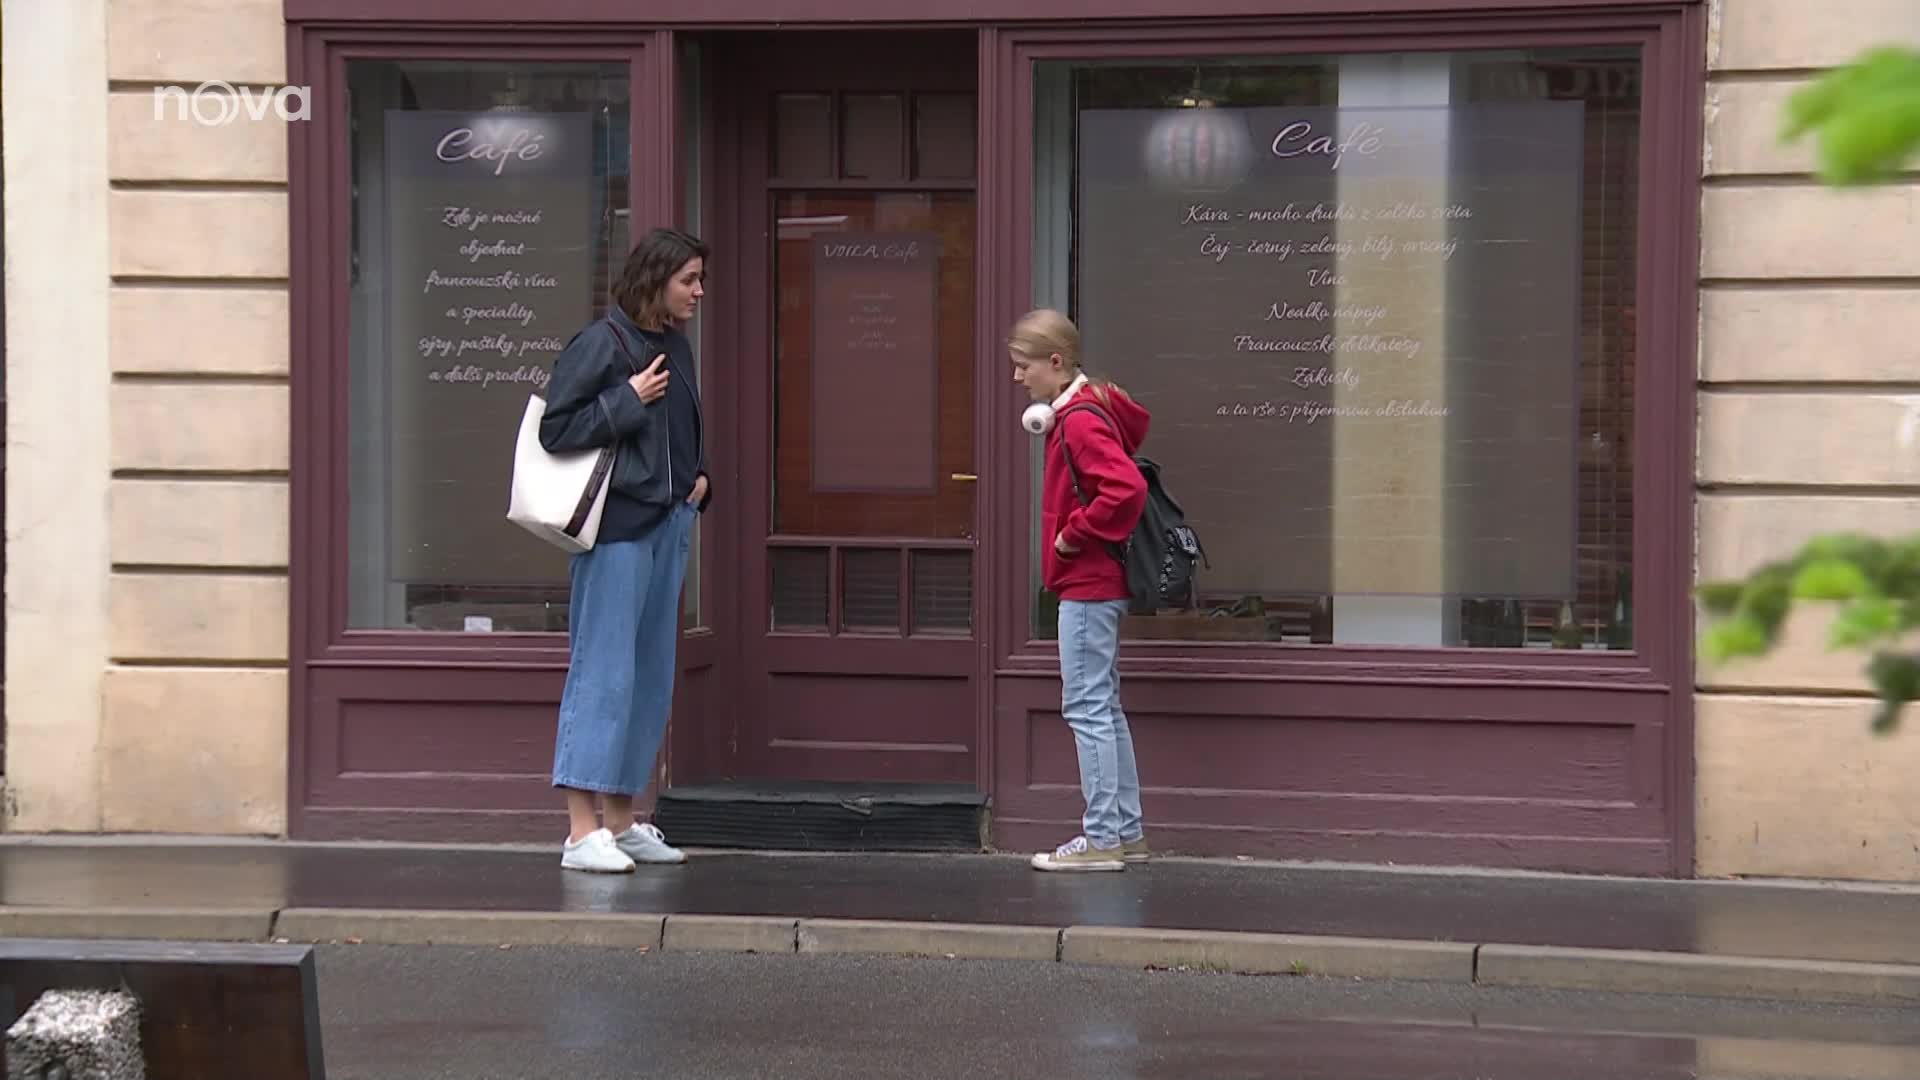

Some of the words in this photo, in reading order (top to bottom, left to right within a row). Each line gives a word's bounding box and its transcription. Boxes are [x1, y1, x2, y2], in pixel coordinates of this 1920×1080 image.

[436, 128, 544, 176] Café
[1272, 121, 1385, 170] Café
[441, 207, 471, 227] Zde
[468, 210, 490, 231] je
[492, 209, 543, 224] možné
[1182, 205, 1230, 224] Káva
[1249, 204, 1301, 221] mnoho
[459, 239, 525, 263] objednat
[1201, 234, 1230, 262] Čaj
[1247, 236, 1296, 261] černý,
[424, 269, 520, 294] francouzská
[524, 272, 557, 287] vína
[445, 308, 457, 318] a
[1264, 302, 1330, 321] Nealko
[1233, 335, 1335, 353] Francouzské
[429, 371, 441, 381] a
[445, 365, 482, 382] další
[1291, 367, 1360, 390] Zákusky
[1217, 406, 1229, 416] a
[1234, 402, 1248, 416] to
[1252, 402, 1275, 416] vše
[1279, 405, 1288, 416] s
[1289, 401, 1371, 424] příjemnou
